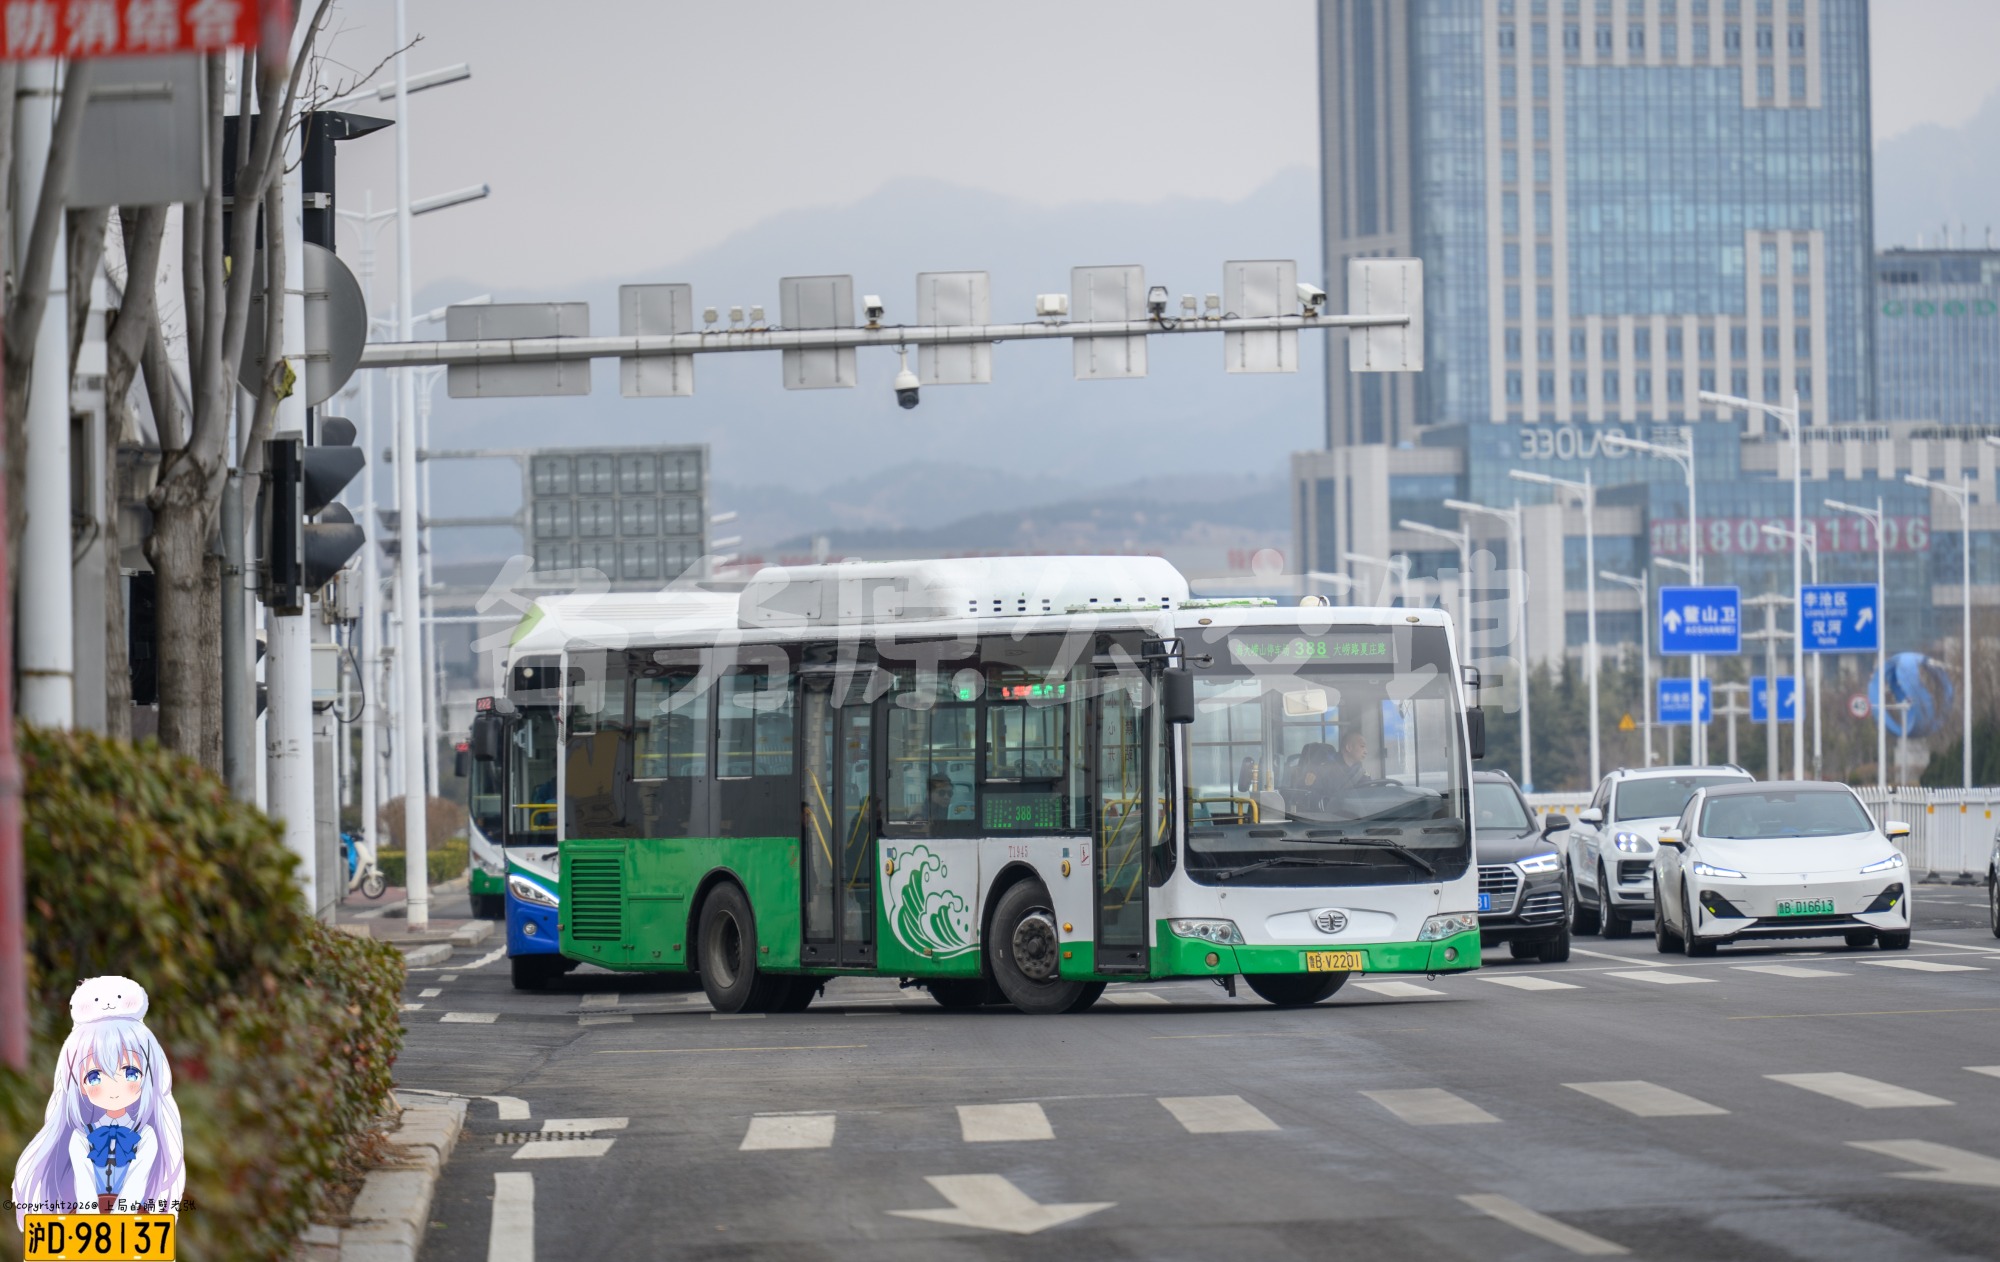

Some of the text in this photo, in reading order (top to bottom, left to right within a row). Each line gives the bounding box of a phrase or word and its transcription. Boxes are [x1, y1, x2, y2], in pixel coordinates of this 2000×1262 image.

[1295, 641, 1327, 656] 388
[1016, 806, 1031, 821] 388
[1008, 845, 1029, 858] T1945
